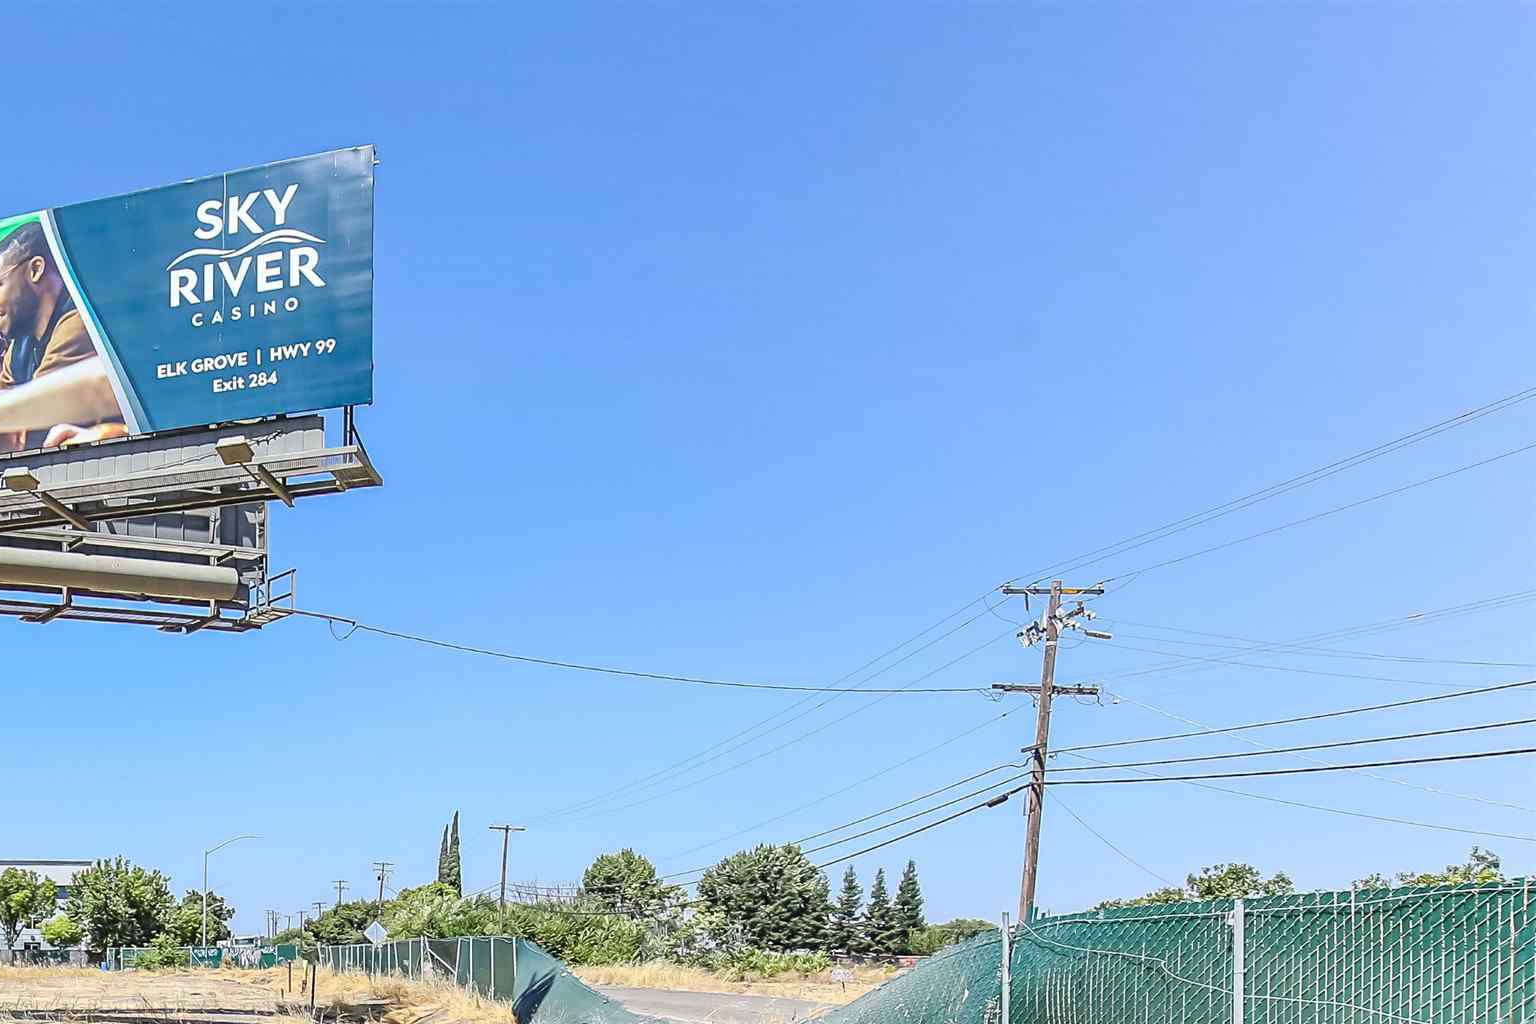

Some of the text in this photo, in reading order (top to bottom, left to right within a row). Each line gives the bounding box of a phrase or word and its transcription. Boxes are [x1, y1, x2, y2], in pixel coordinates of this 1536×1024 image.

[193, 183, 299, 240] SKY
[169, 246, 327, 308] RIVER
[191, 297, 299, 327] CASINO
[157, 361, 188, 379] ELK
[191, 352, 248, 374] GROVE
[269, 342, 312, 362] HWY
[315, 338, 336, 355] 99
[212, 371, 278, 393] Exit 284
